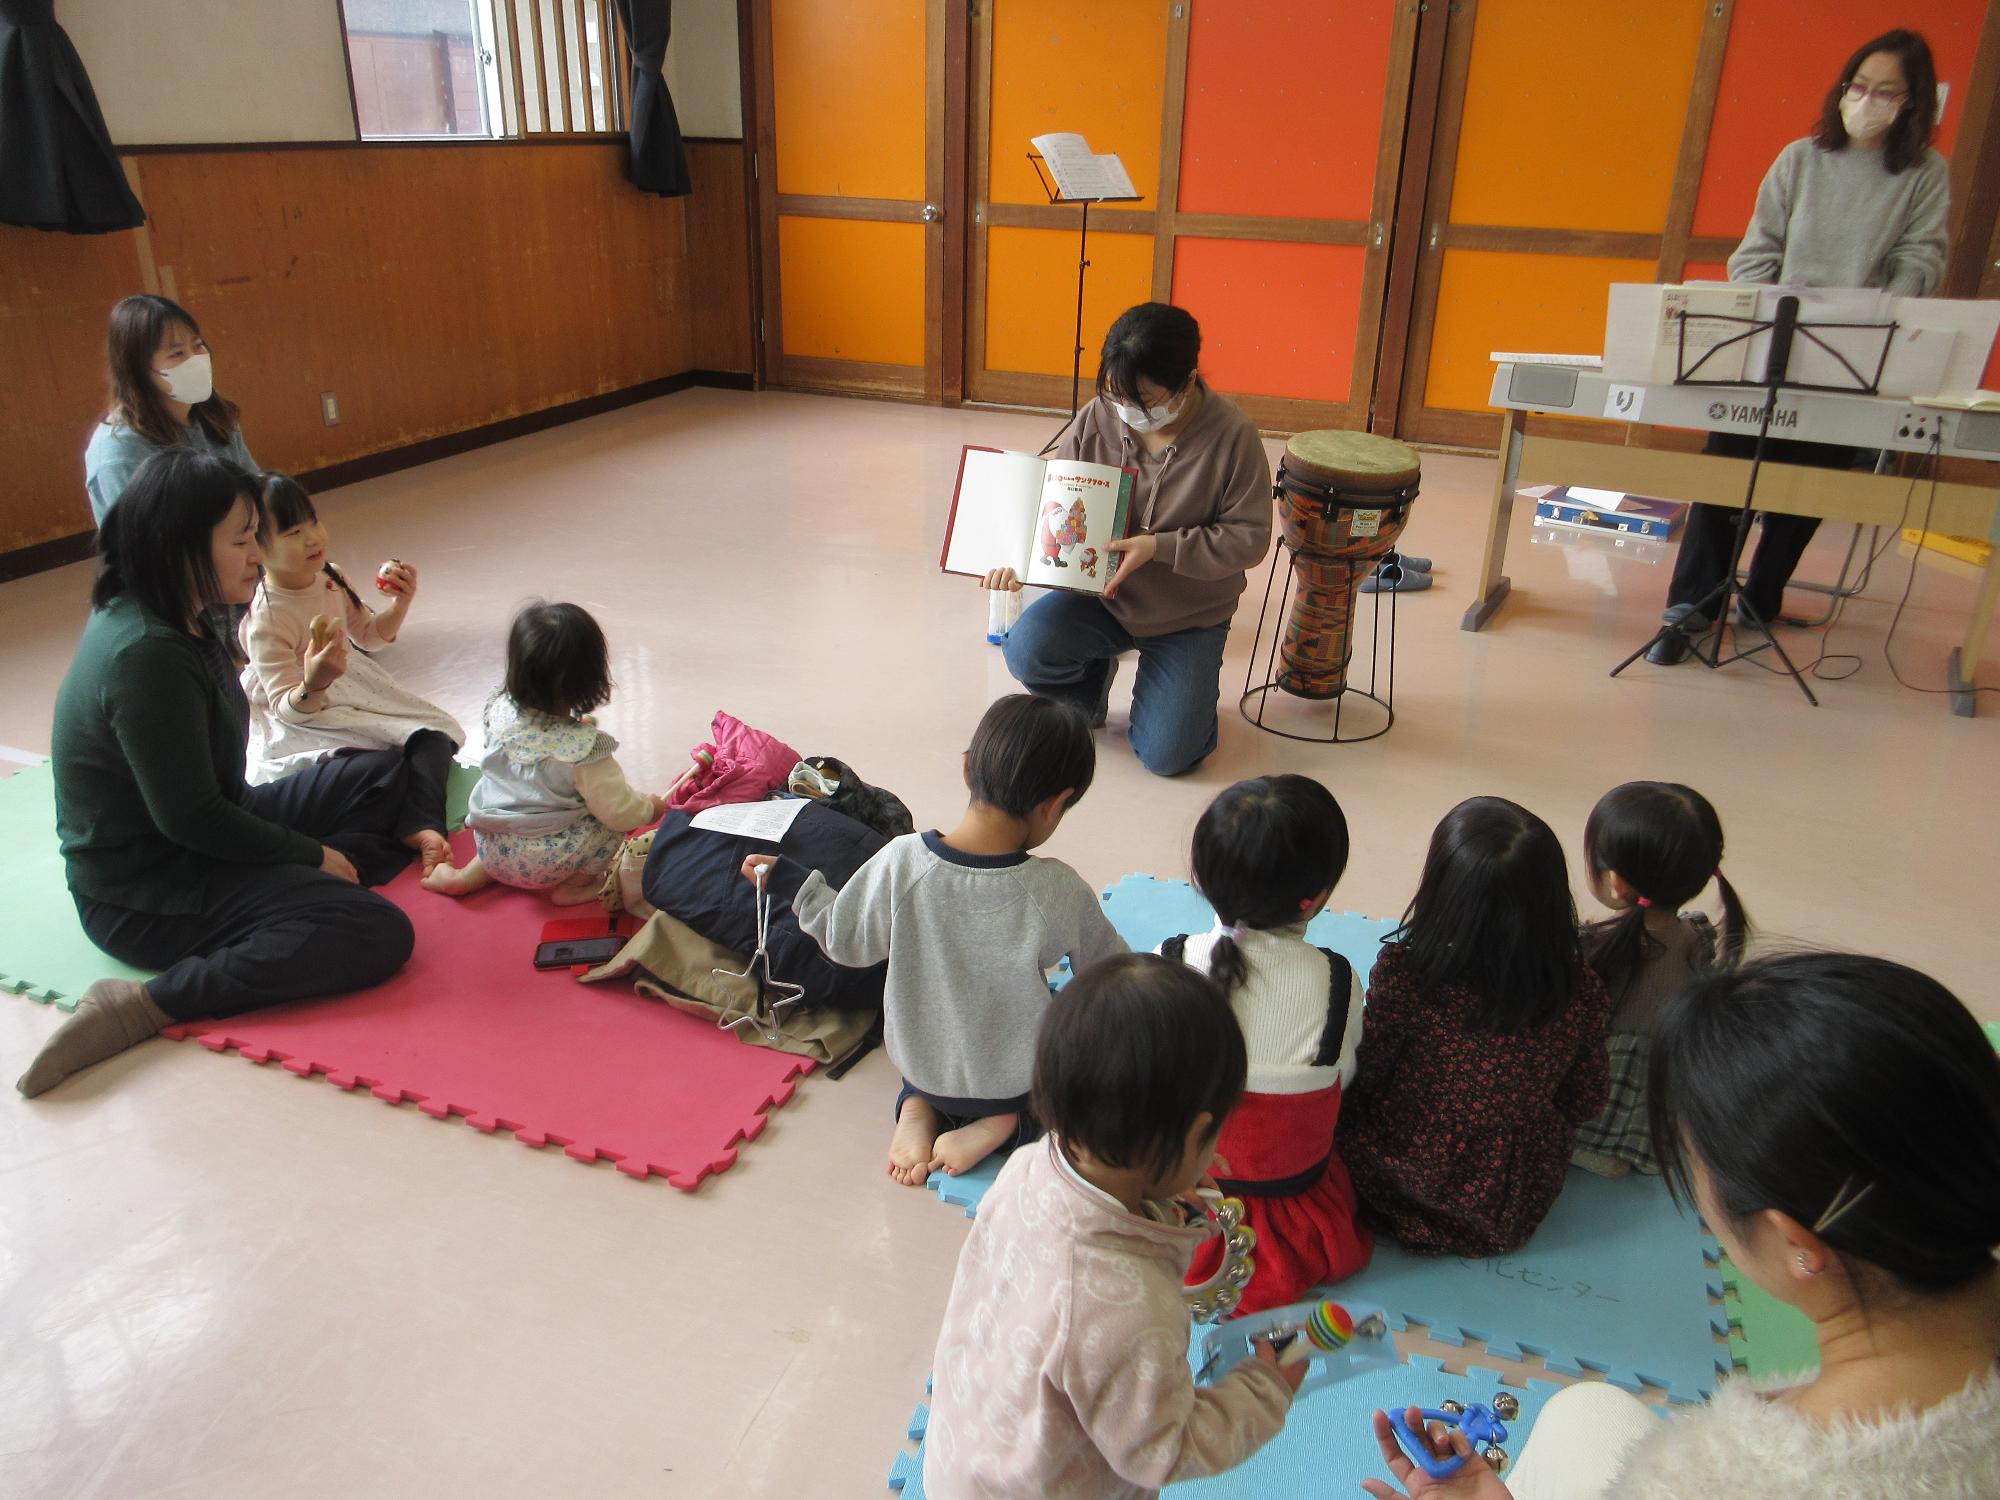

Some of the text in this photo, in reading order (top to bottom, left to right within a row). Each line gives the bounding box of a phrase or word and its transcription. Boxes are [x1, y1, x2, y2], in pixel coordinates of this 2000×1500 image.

[1615, 390, 1635, 413] り
[1458, 1256, 1622, 1302] 化センター
